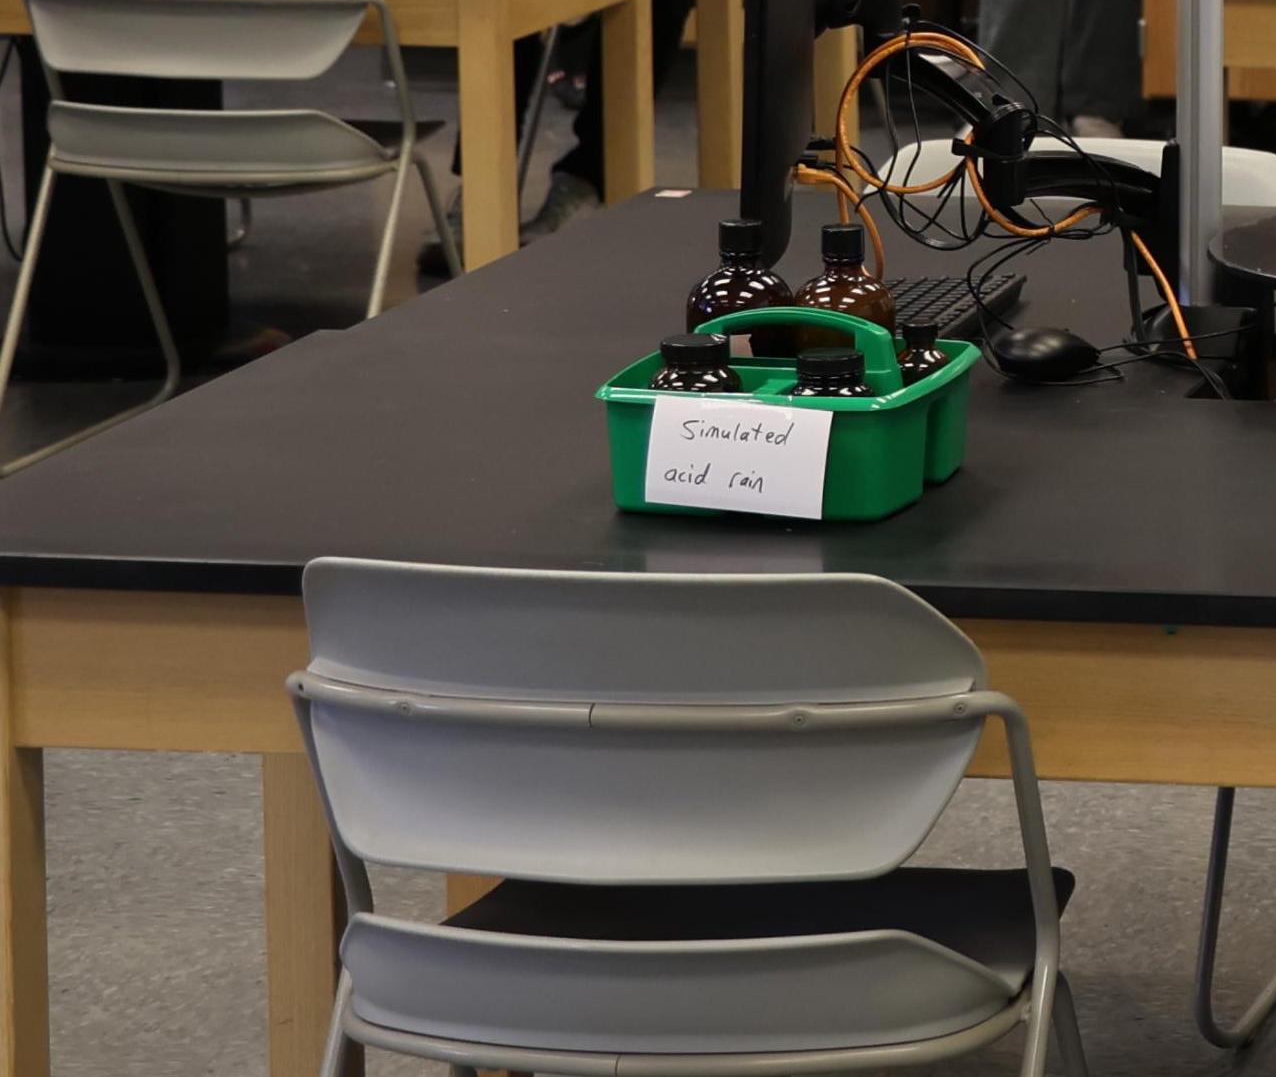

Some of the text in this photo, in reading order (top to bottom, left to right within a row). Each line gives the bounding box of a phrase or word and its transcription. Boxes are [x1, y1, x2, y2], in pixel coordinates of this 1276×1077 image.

[682, 419, 795, 446] Simulated
[663, 463, 764, 494] acid rain
